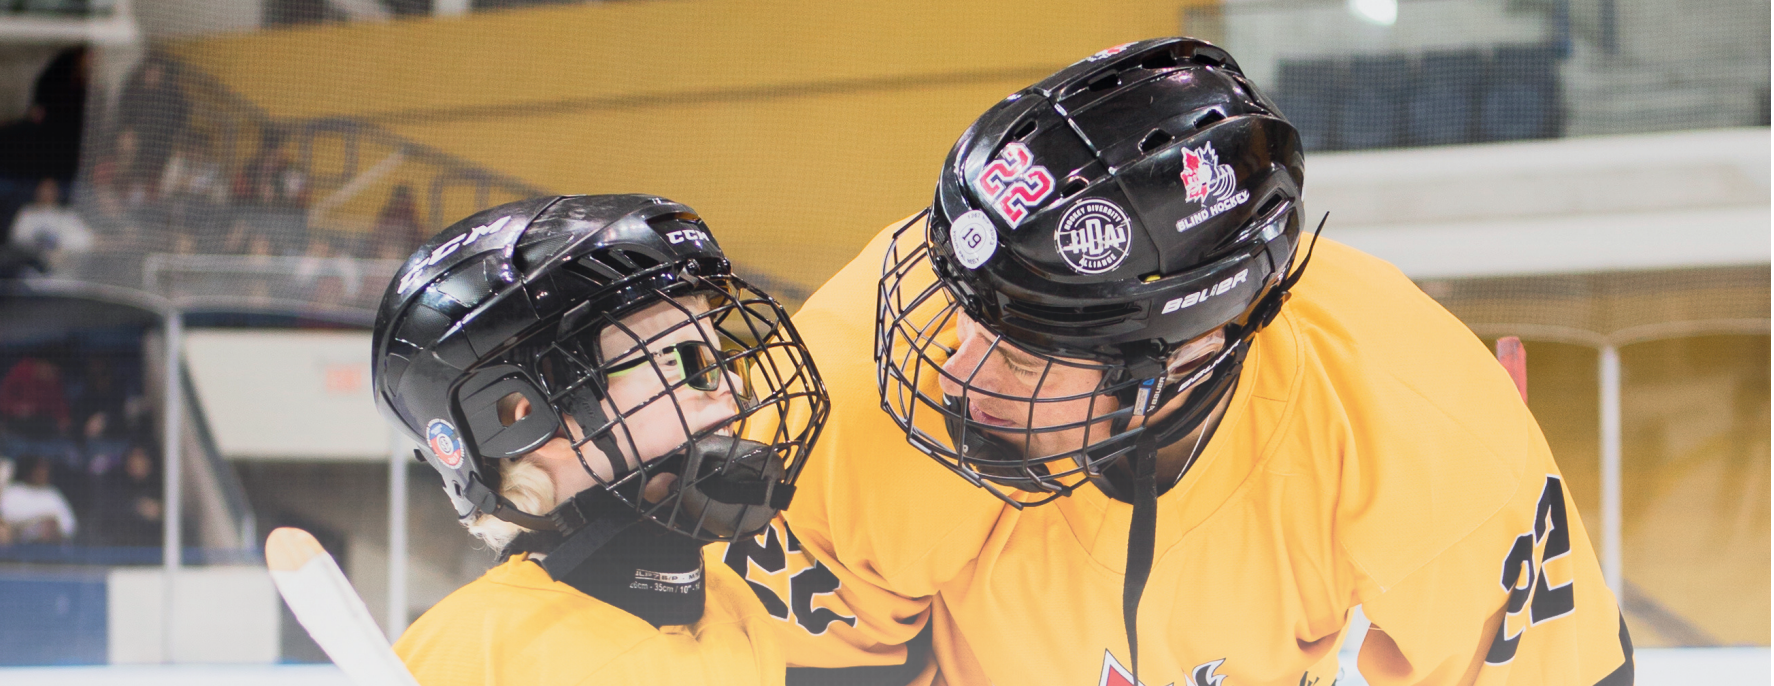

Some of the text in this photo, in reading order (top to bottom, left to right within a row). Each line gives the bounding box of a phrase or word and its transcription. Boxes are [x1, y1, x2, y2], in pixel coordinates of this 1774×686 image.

[975, 142, 1056, 230] 22
[1064, 204, 1122, 230] HOCKEY DIVERSITY
[1177, 189, 1249, 231] BLIND HOCKEY
[666, 229, 710, 244] CCM
[962, 228, 982, 249] 19
[397, 216, 511, 294] CCM
[1079, 253, 1117, 268] ALLIANCE
[1161, 268, 1249, 314] BAUER
[1151, 376, 1166, 406] BAUER
[654, 583, 674, 593] 35cm
